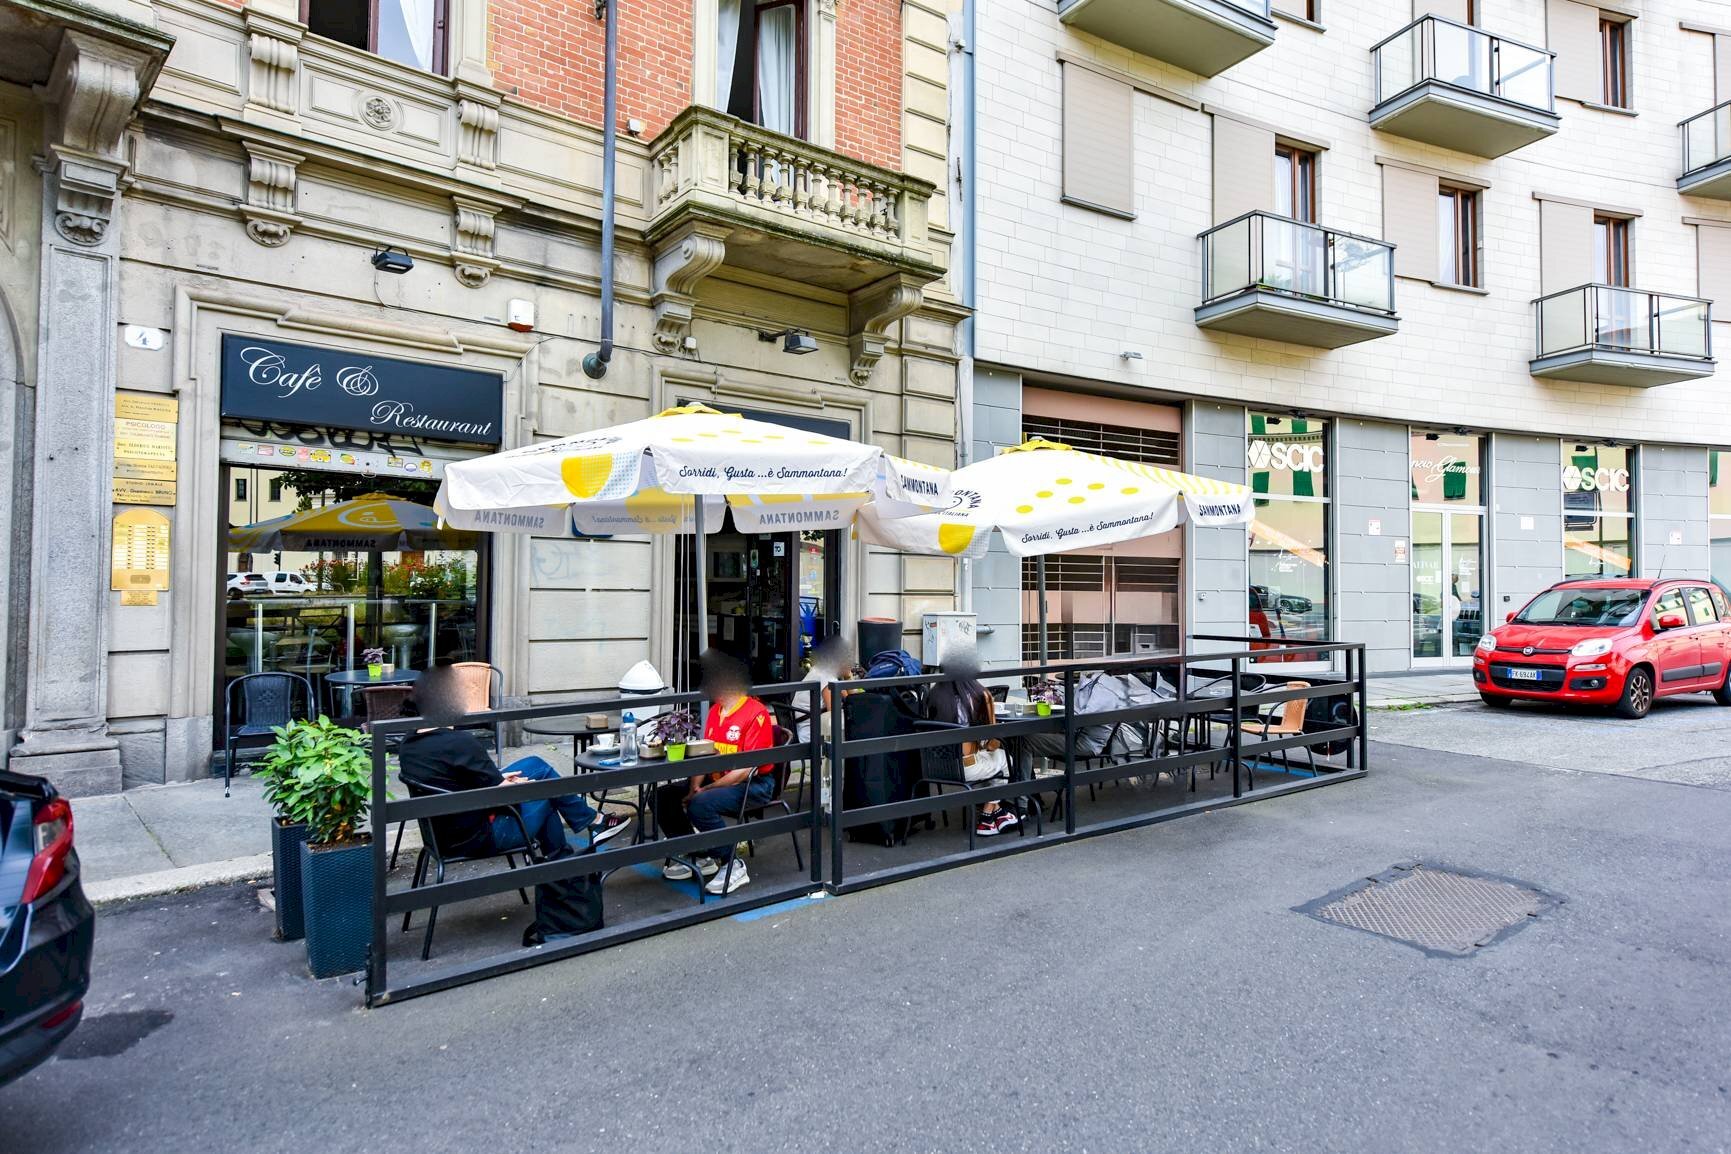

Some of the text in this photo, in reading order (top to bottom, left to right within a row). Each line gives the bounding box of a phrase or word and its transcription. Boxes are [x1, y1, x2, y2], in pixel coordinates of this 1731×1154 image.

[336, 365, 379, 396] &
[370, 400, 492, 436] Restaurant
[1270, 441, 1324, 473] SCIC
[679, 465, 720, 480] Sorridi,
[724, 466, 755, 481] Gusta
[776, 466, 848, 480] Sammontana!
[1580, 466, 1630, 493] SCIC
[1199, 503, 1241, 517] SAMMONTANA
[1021, 532, 1053, 544] Sorridi,
[1055, 528, 1080, 540] Gusta
[1096, 512, 1154, 531] Sammontana!
